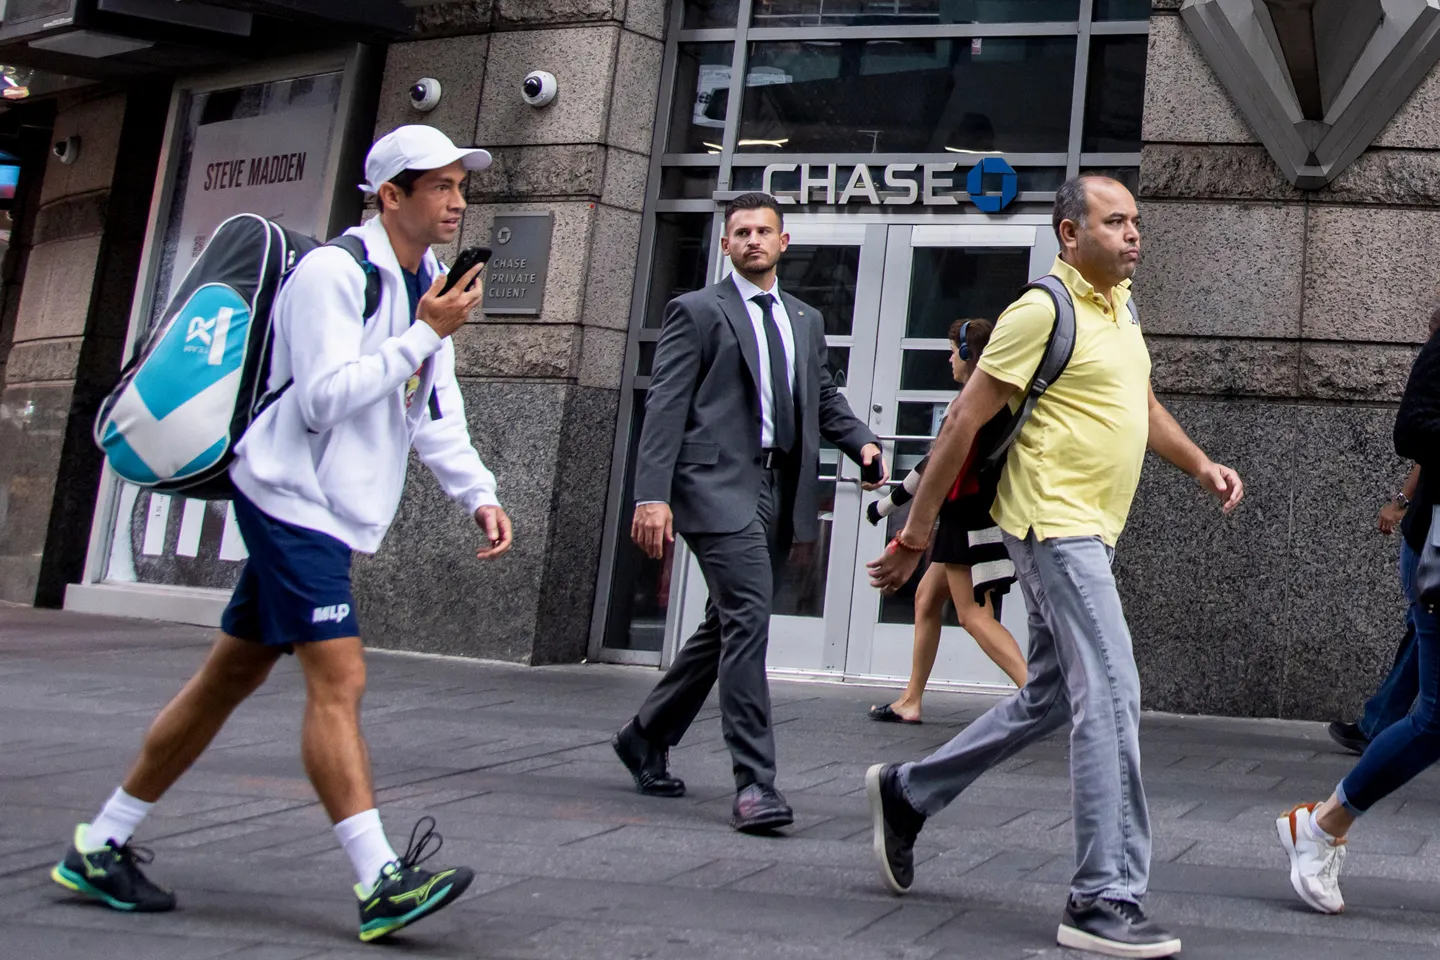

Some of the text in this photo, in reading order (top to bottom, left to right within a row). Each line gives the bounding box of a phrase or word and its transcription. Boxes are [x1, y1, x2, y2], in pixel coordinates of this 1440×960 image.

[204, 151, 307, 191] STEVE MADDEN
[762, 162, 960, 205] CHASE
[493, 258, 527, 269] CHASE
[491, 273, 536, 284] PRIVATE
[488, 287, 527, 298] CLIENT
